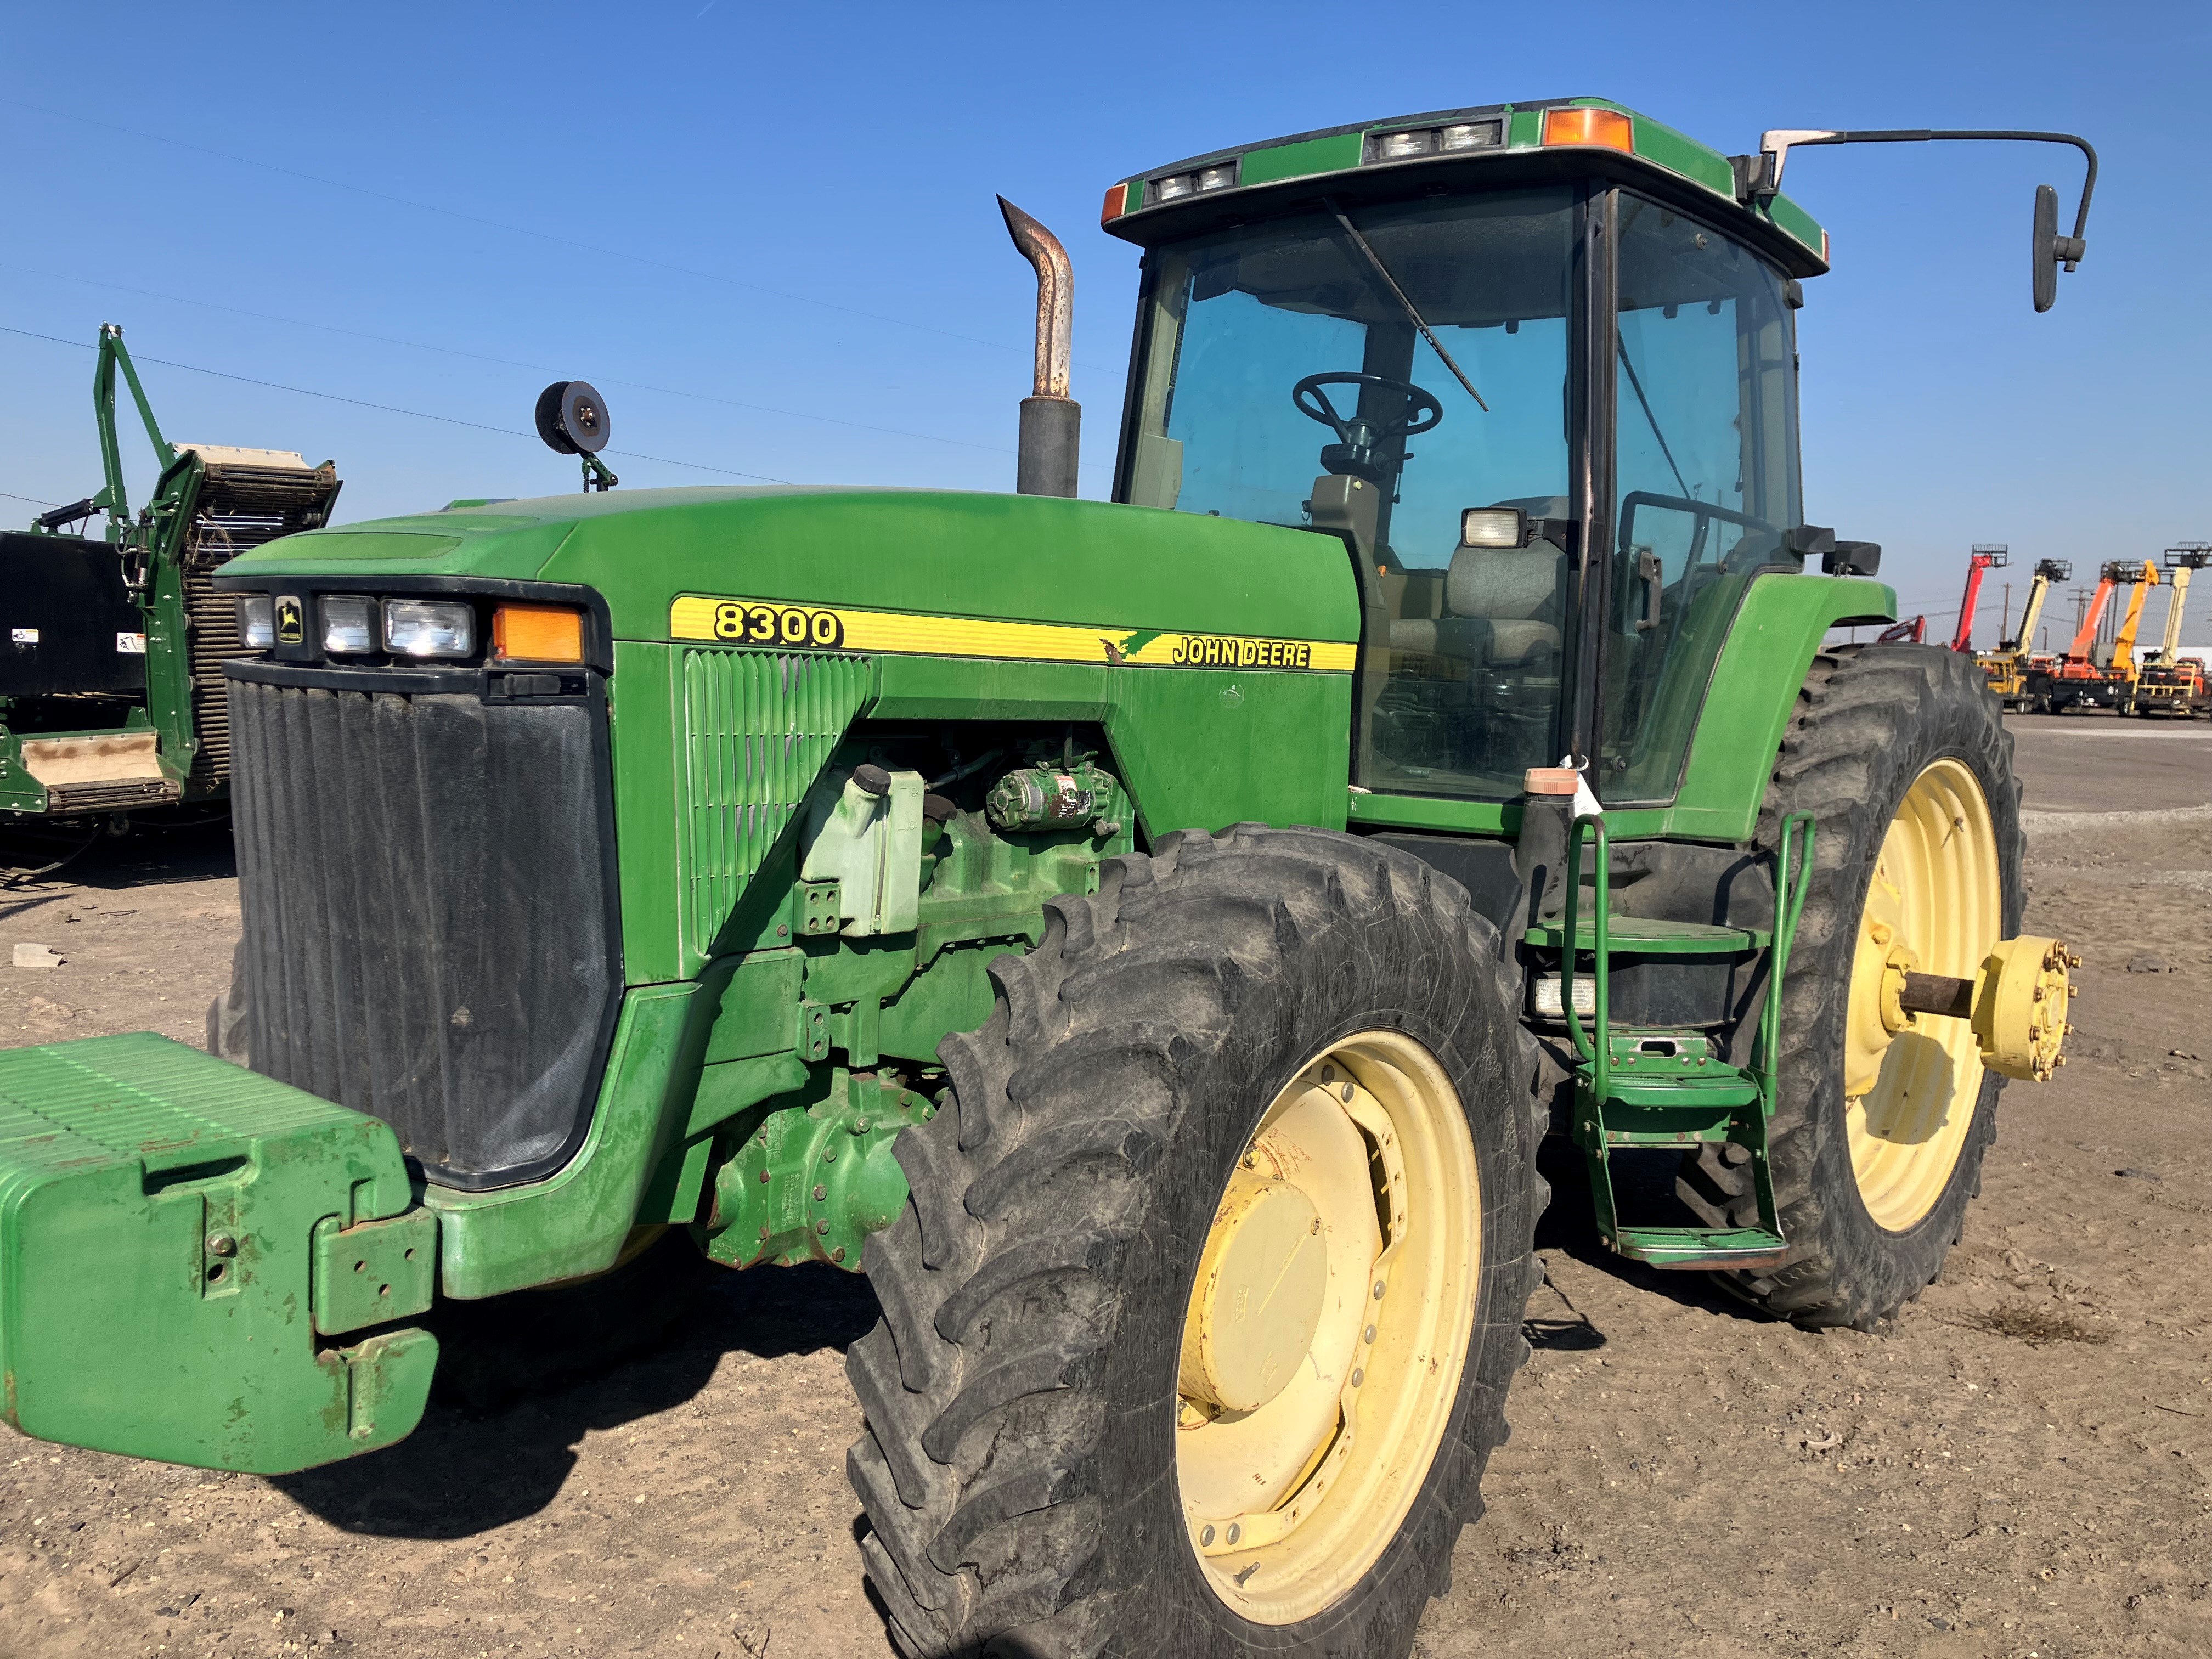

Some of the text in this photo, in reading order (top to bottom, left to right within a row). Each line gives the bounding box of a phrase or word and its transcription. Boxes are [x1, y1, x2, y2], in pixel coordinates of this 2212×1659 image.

[714, 603, 844, 648] 8300
[1173, 637, 1311, 669] JOHN DEERE
